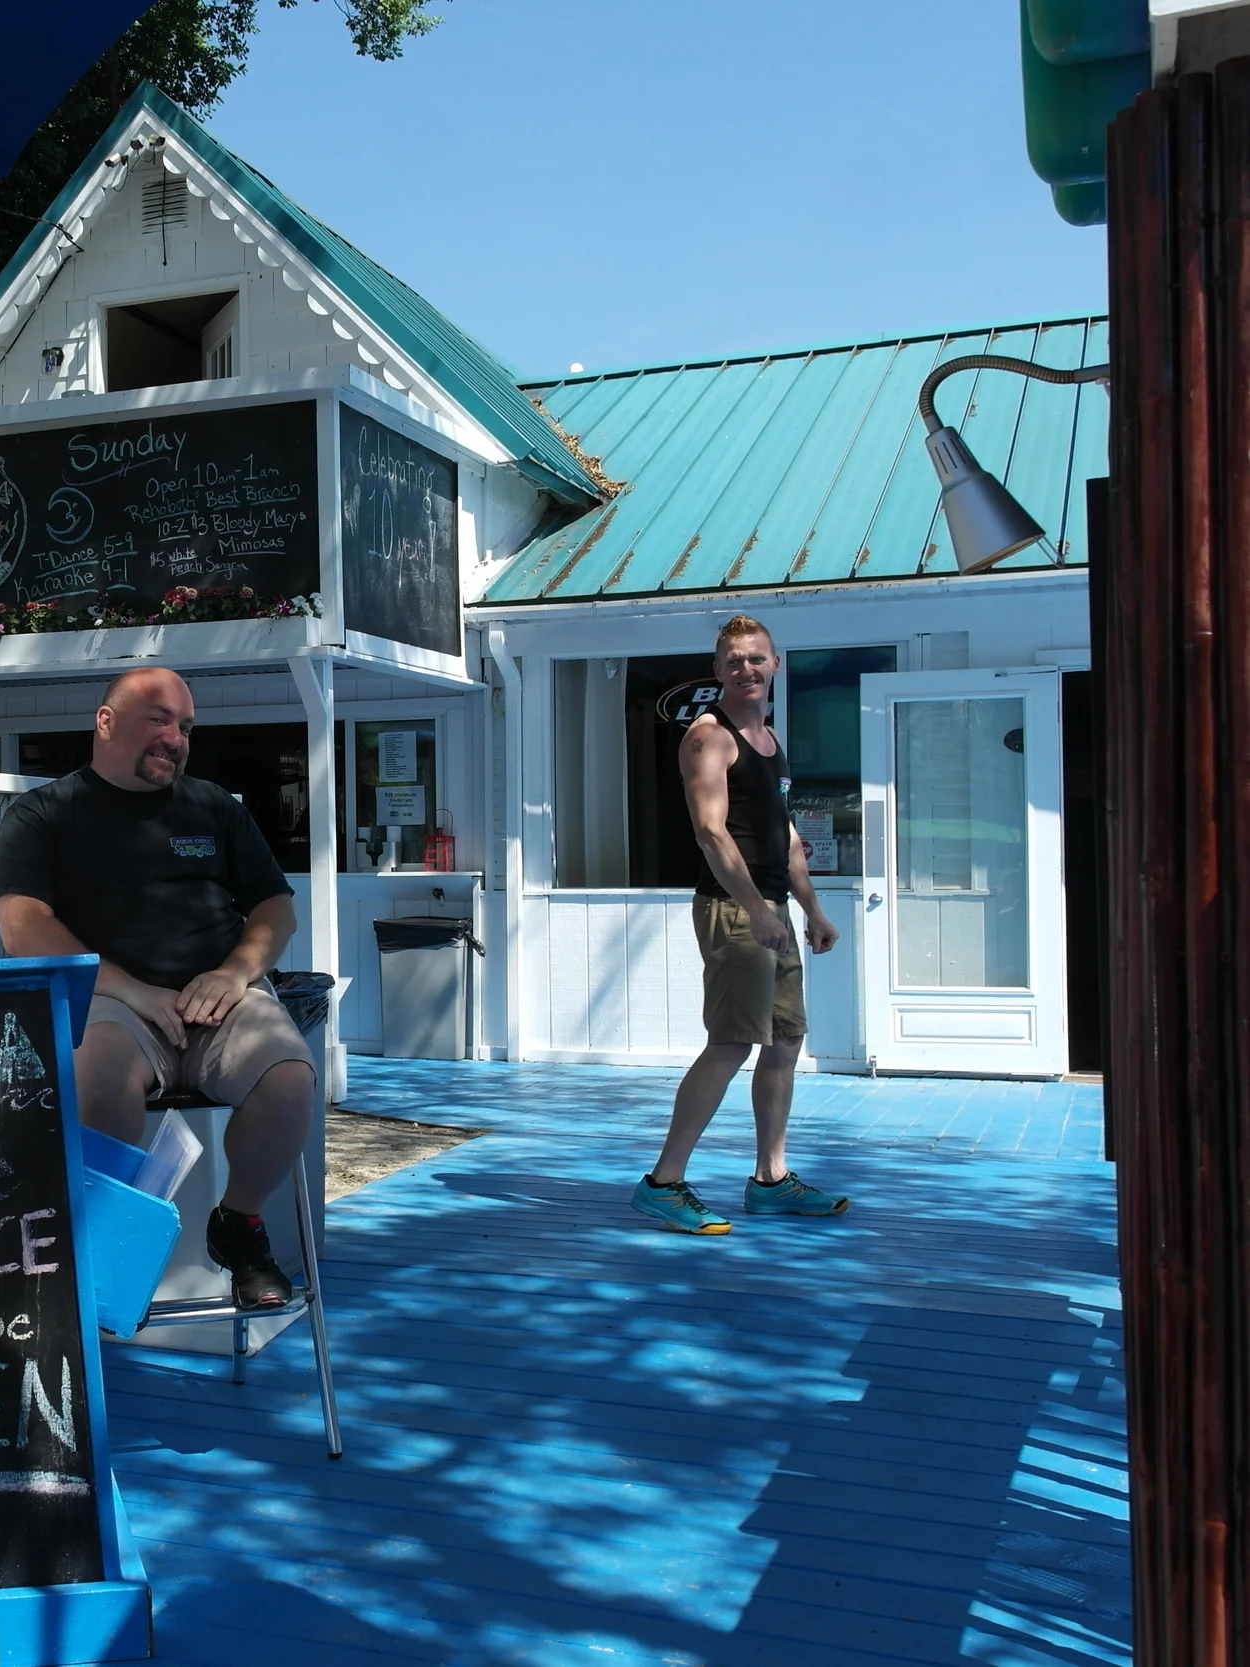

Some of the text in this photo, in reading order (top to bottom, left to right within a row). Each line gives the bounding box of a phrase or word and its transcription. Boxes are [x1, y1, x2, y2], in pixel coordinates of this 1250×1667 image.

[67, 422, 187, 471] Sunday
[358, 426, 435, 513] Celebrating
[146, 477, 188, 501] Open
[204, 485, 240, 507] Best
[242, 480, 300, 501] Brunch
[158, 508, 307, 538] 10-2 $3 Bloody Marys
[368, 487, 394, 559] 10
[32, 532, 134, 570] T-Dance 5-9
[218, 536, 285, 555] Mimosas
[102, 558, 128, 583] 9-1
[168, 556, 249, 580] Peach Sangria
